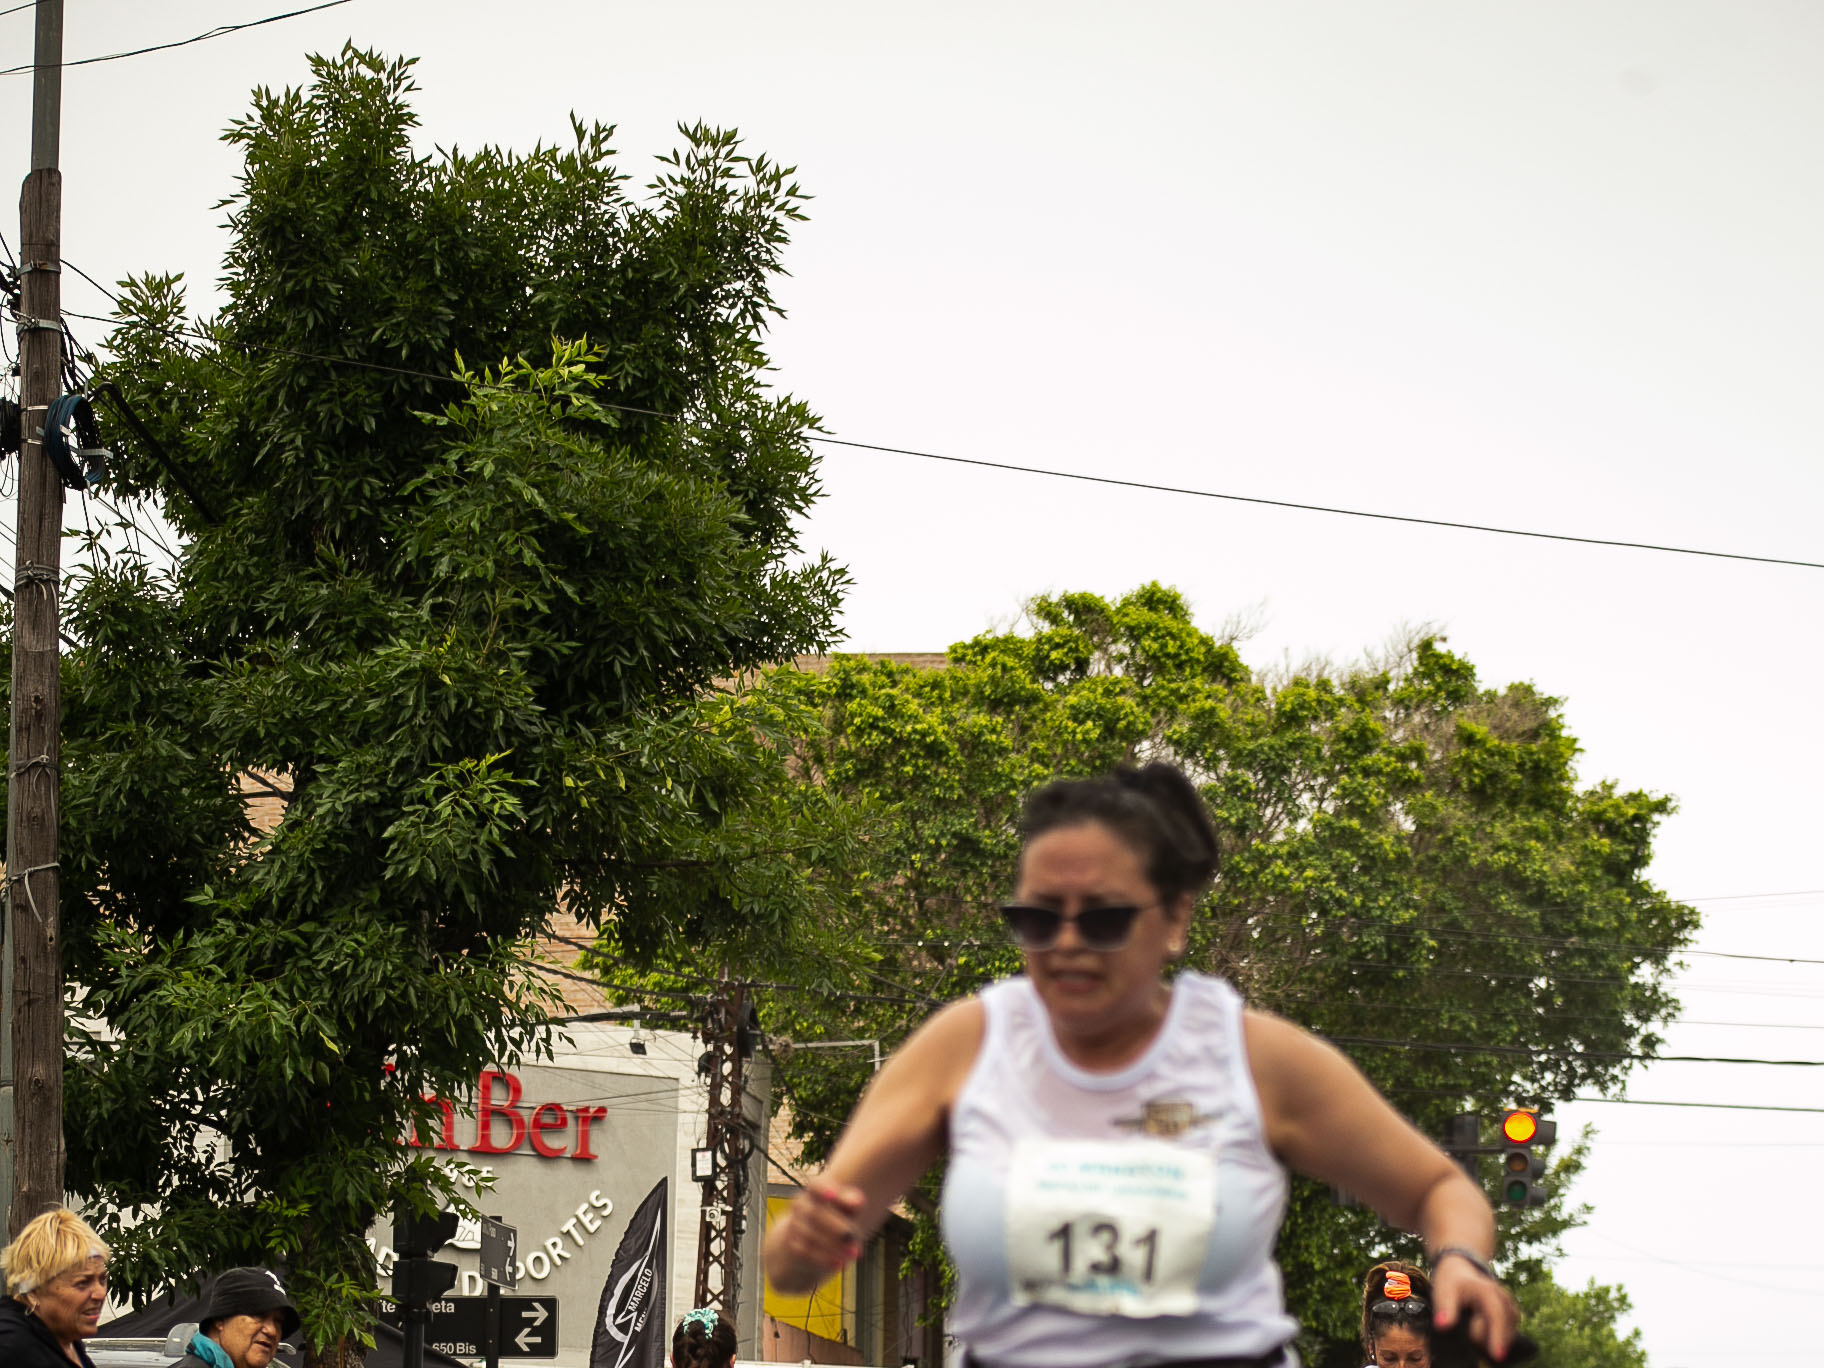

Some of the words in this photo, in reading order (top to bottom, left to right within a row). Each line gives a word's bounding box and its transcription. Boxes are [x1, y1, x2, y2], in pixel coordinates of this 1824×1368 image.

[1047, 1221, 1160, 1283] 131
[628, 1268, 653, 1312] MARCELO
[456, 1341, 477, 1354] Bis
